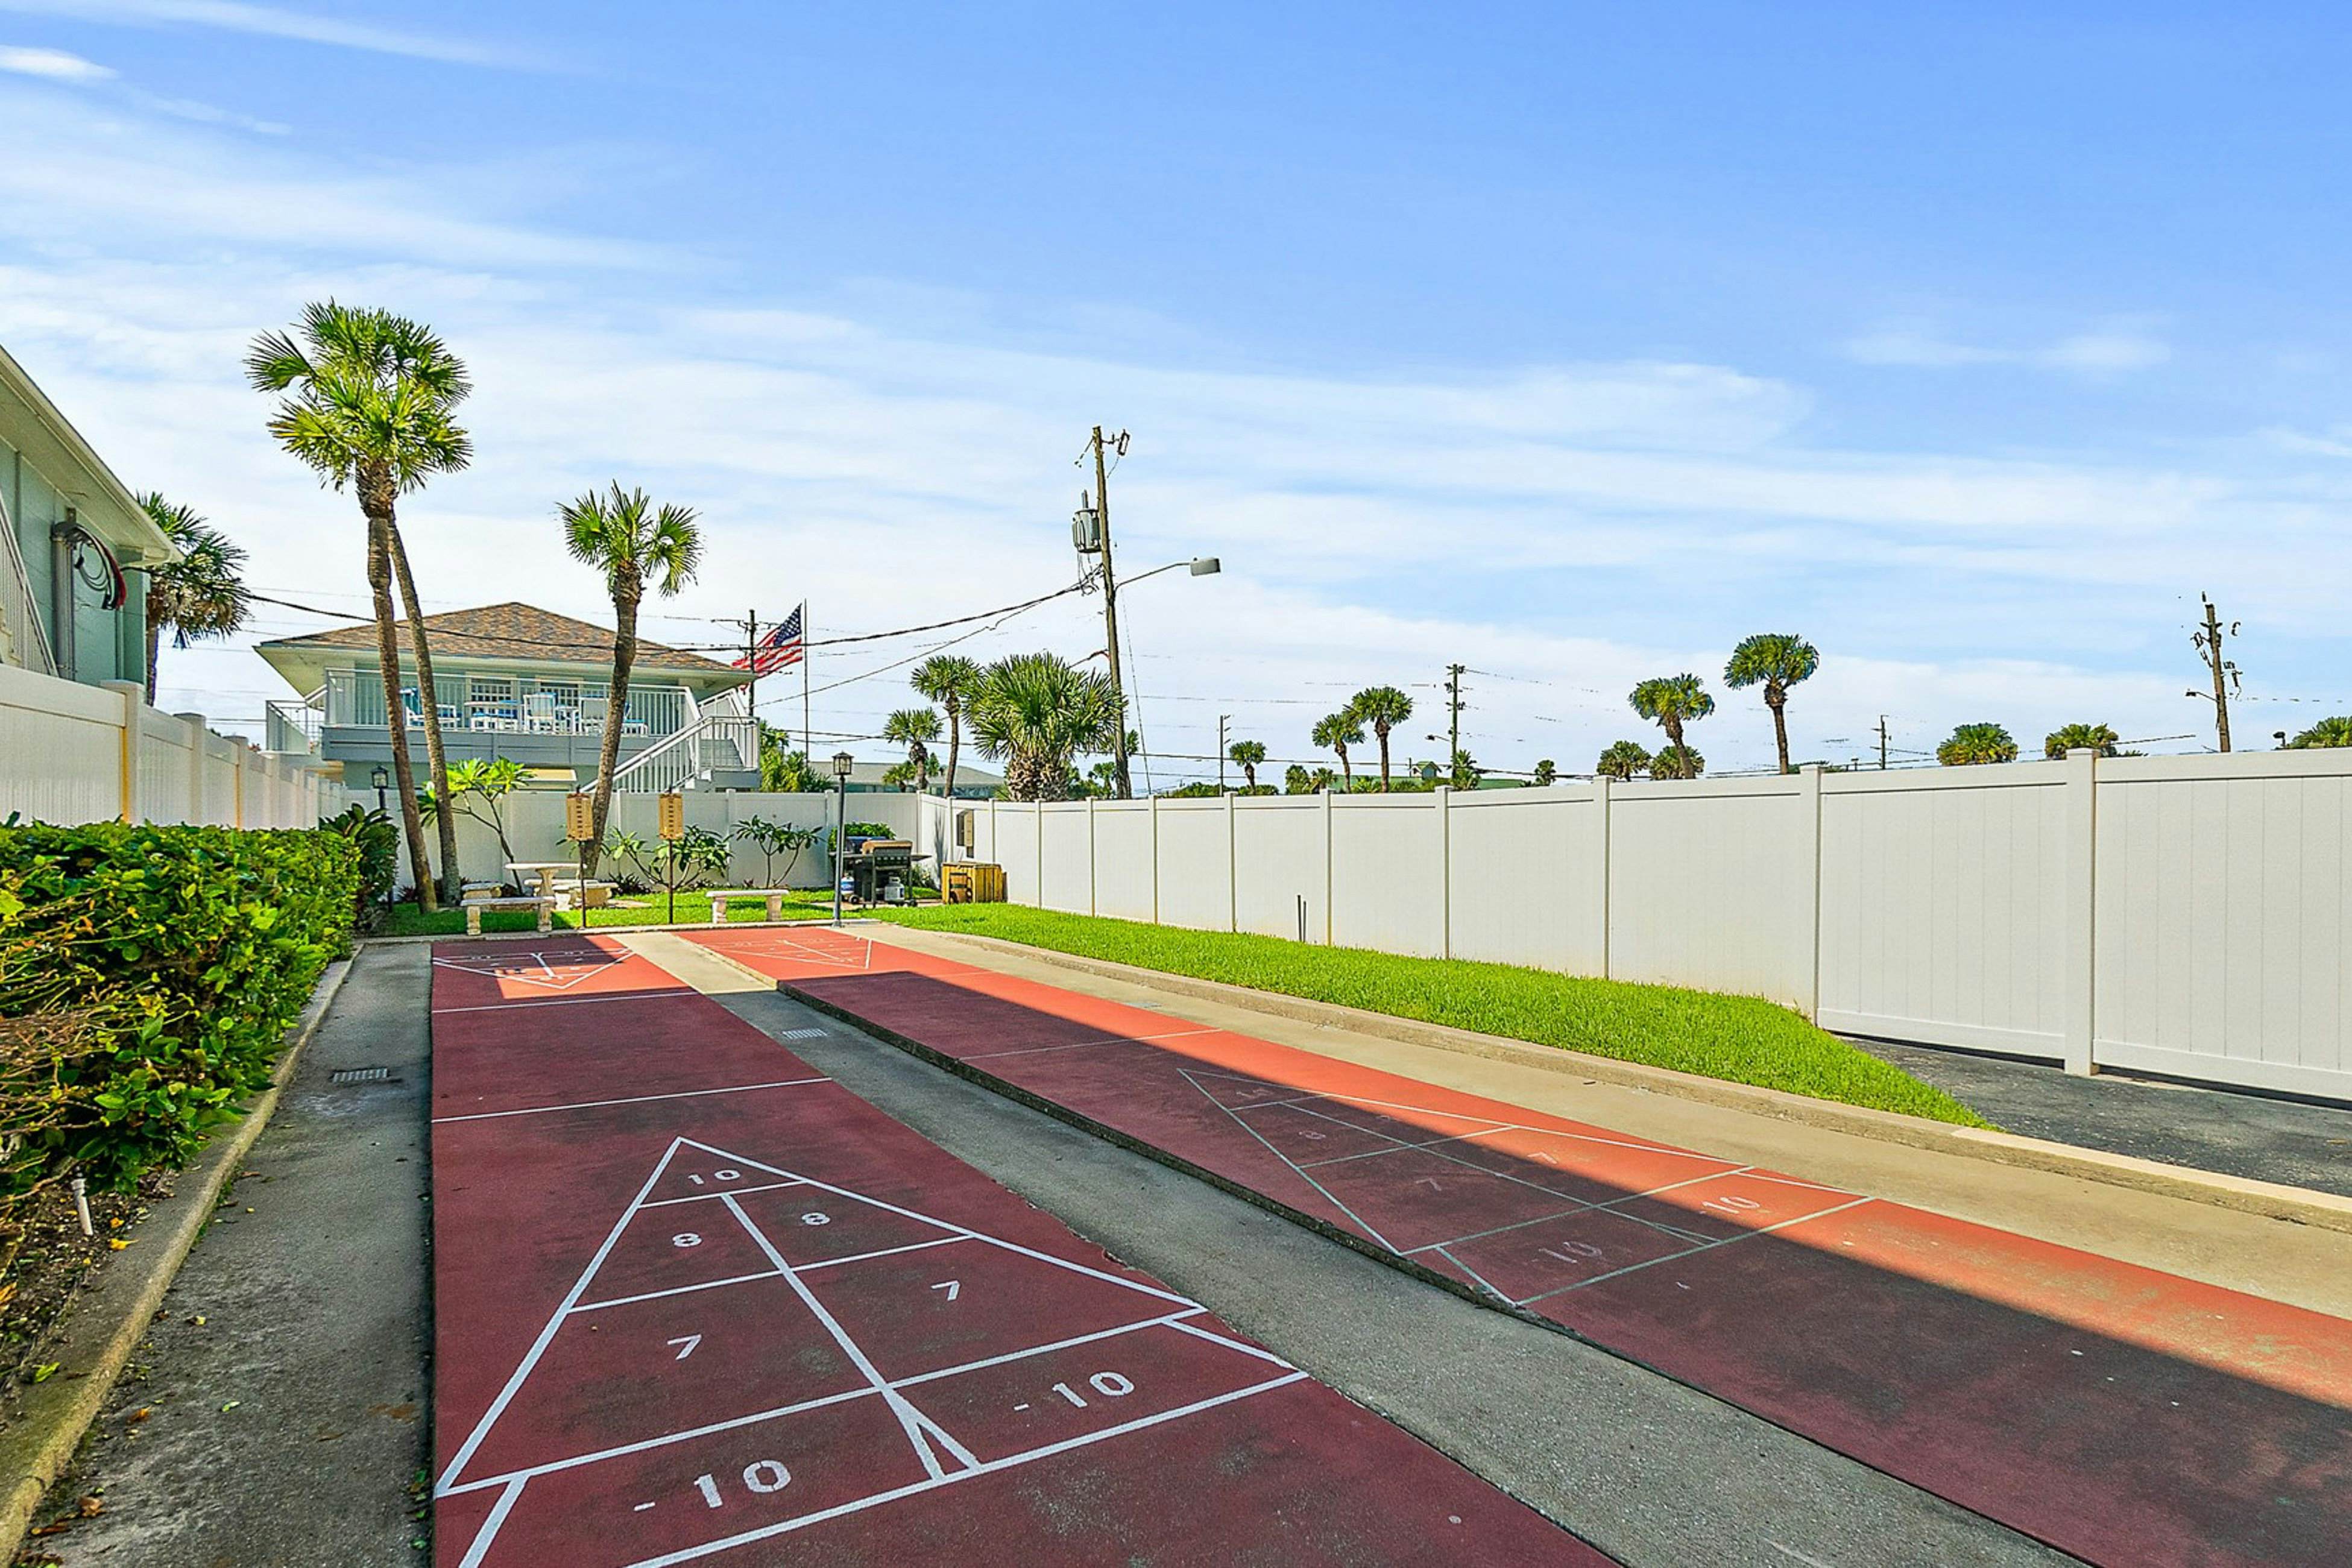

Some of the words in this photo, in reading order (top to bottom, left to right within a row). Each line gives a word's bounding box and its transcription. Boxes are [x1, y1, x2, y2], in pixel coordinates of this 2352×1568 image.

[688, 1170, 740, 1185] 10
[801, 1212, 830, 1226] 8
[672, 1233, 702, 1247] 8
[931, 1280, 960, 1301] 7
[667, 1334, 702, 1360] 7
